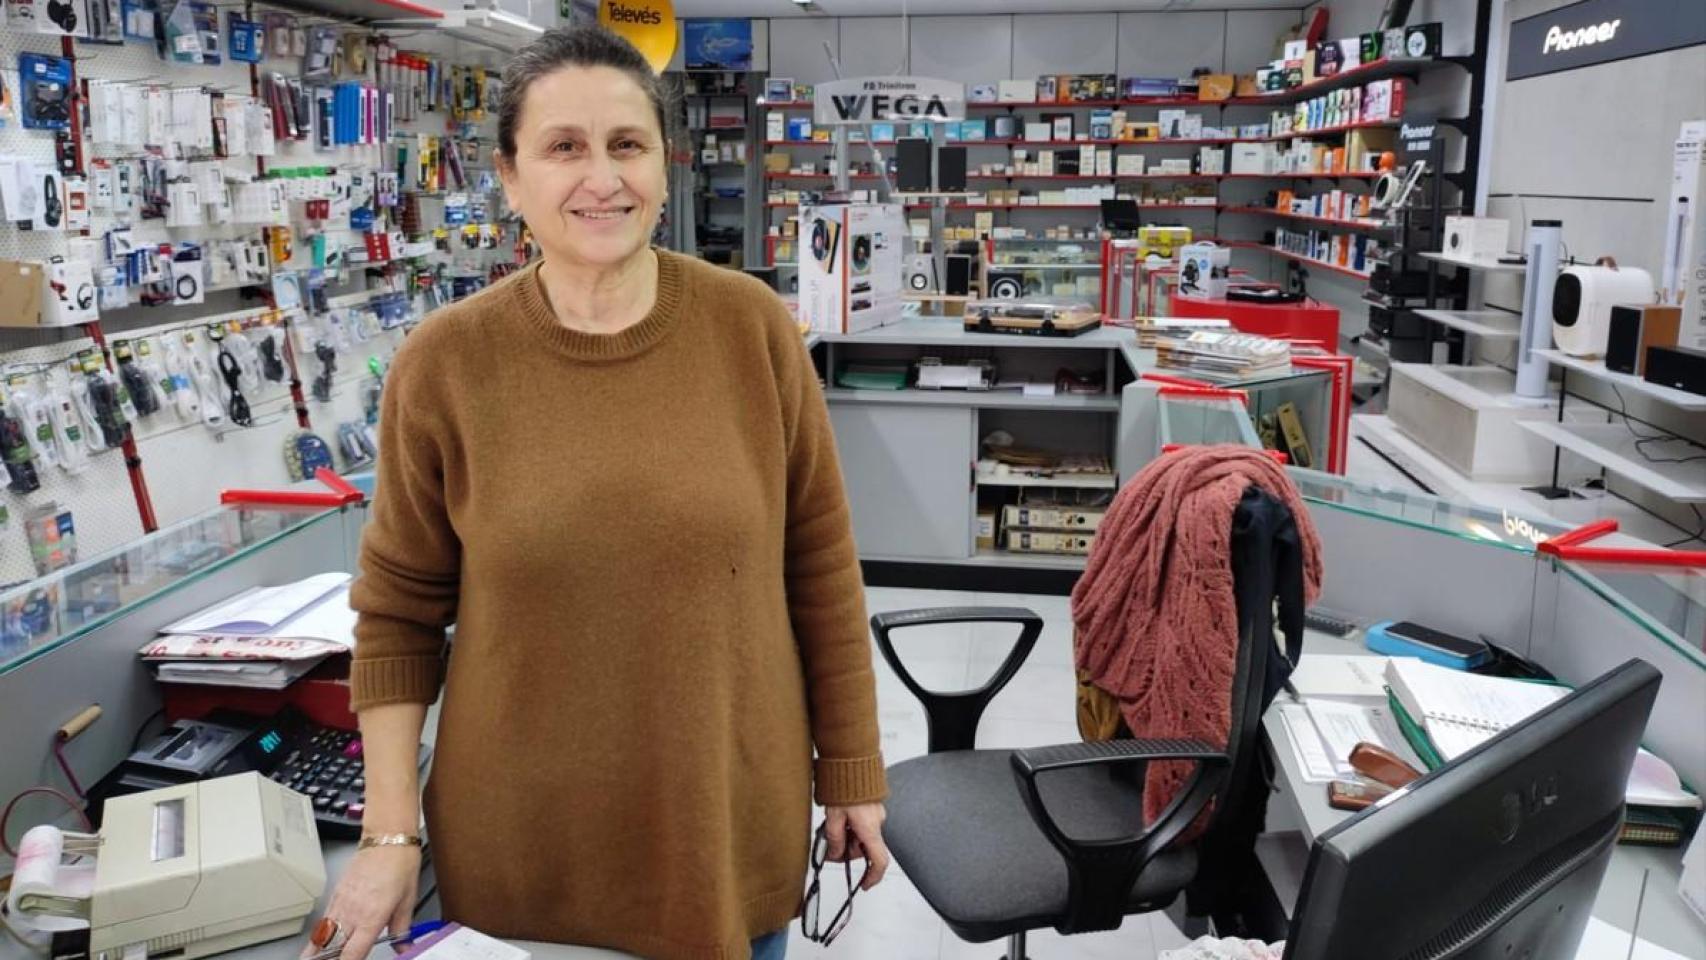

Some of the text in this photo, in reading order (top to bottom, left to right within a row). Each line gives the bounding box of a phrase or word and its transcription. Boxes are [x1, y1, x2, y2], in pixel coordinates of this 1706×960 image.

[607, 3, 662, 25] Televés
[1543, 19, 1621, 54] Pioneer
[831, 94, 949, 121] WEGA
